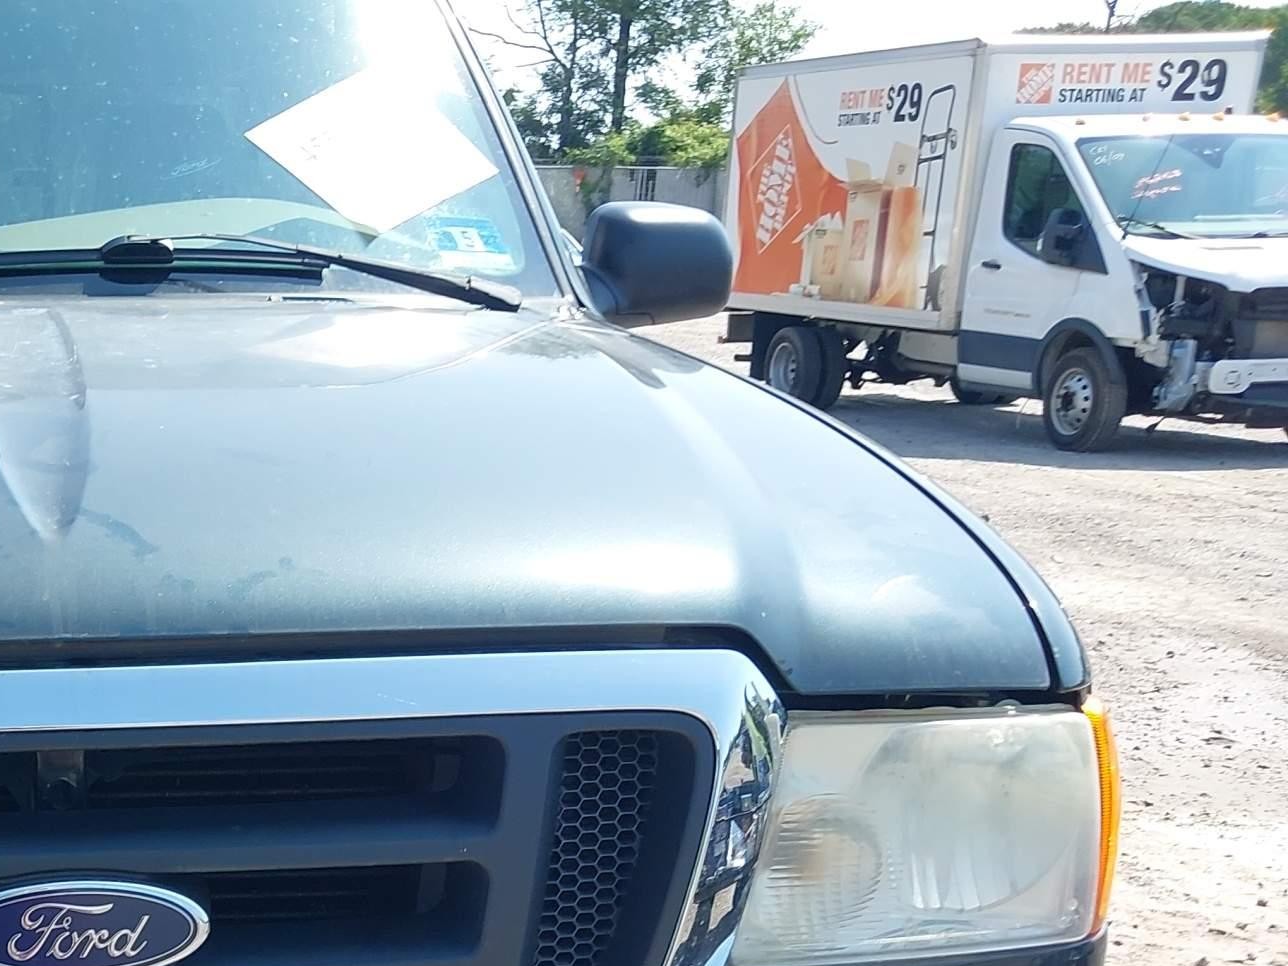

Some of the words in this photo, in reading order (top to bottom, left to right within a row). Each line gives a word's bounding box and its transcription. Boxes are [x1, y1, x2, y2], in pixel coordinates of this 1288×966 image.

[1058, 88, 1125, 103] STARTING
[1128, 87, 1148, 102] AT
[1062, 62, 1116, 84] RENT
[1120, 61, 1153, 83] ME
[1157, 58, 1227, 102] $29
[840, 90, 868, 109] RENT
[868, 88, 885, 108] ME
[886, 82, 922, 123] $29
[7, 902, 149, 962] Ford
